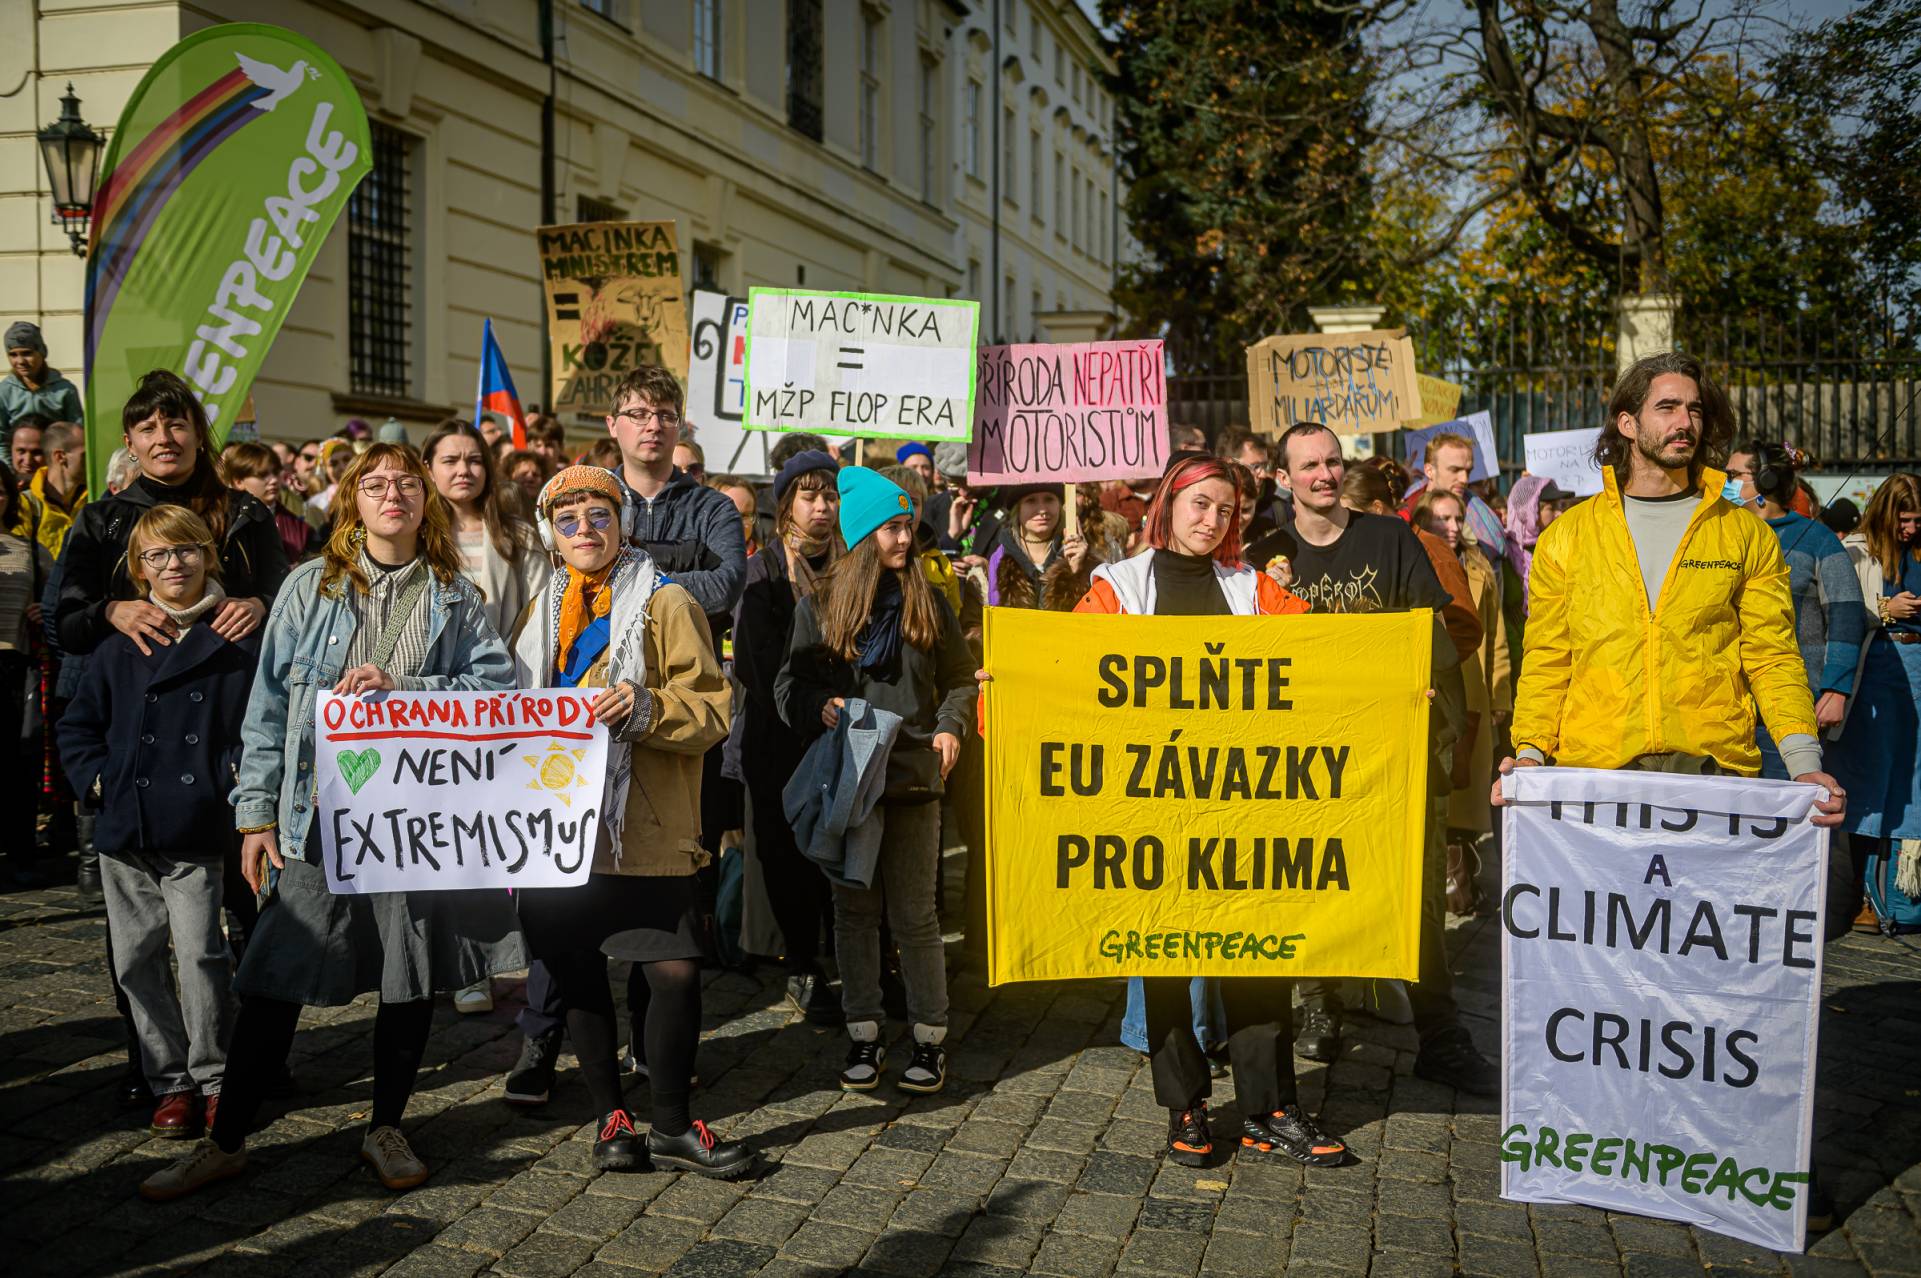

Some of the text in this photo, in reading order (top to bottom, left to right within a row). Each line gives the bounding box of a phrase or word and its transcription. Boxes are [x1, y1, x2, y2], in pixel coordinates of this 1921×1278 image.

[184, 102, 358, 426] ENPEACE
[544, 252, 679, 280] MINISTREM
[756, 382, 815, 420] MŽP
[830, 390, 888, 423] FLOP
[898, 395, 954, 428] ERA
[1073, 342, 1164, 407] NEPATŘÍ
[980, 407, 1160, 477] MOTORISTŮM
[1680, 559, 1743, 571] GREENPEACE
[1097, 642, 1294, 711] SPLŇTE
[323, 693, 600, 731] OCHRANA PŘÍRODY
[393, 743, 518, 786] NENÍ
[1040, 729, 1351, 800] EU ZÁVAZKY
[333, 808, 596, 882] EXTREMISMUS
[1056, 834, 1351, 891] PRO KLIMA
[1644, 854, 1673, 887] A
[1099, 930, 1306, 963] GREENPEACE
[1502, 883, 1818, 968] CLIMATE
[1545, 1007, 1760, 1088] CRISIS
[1500, 1124, 1810, 1211] GREENPEACE
